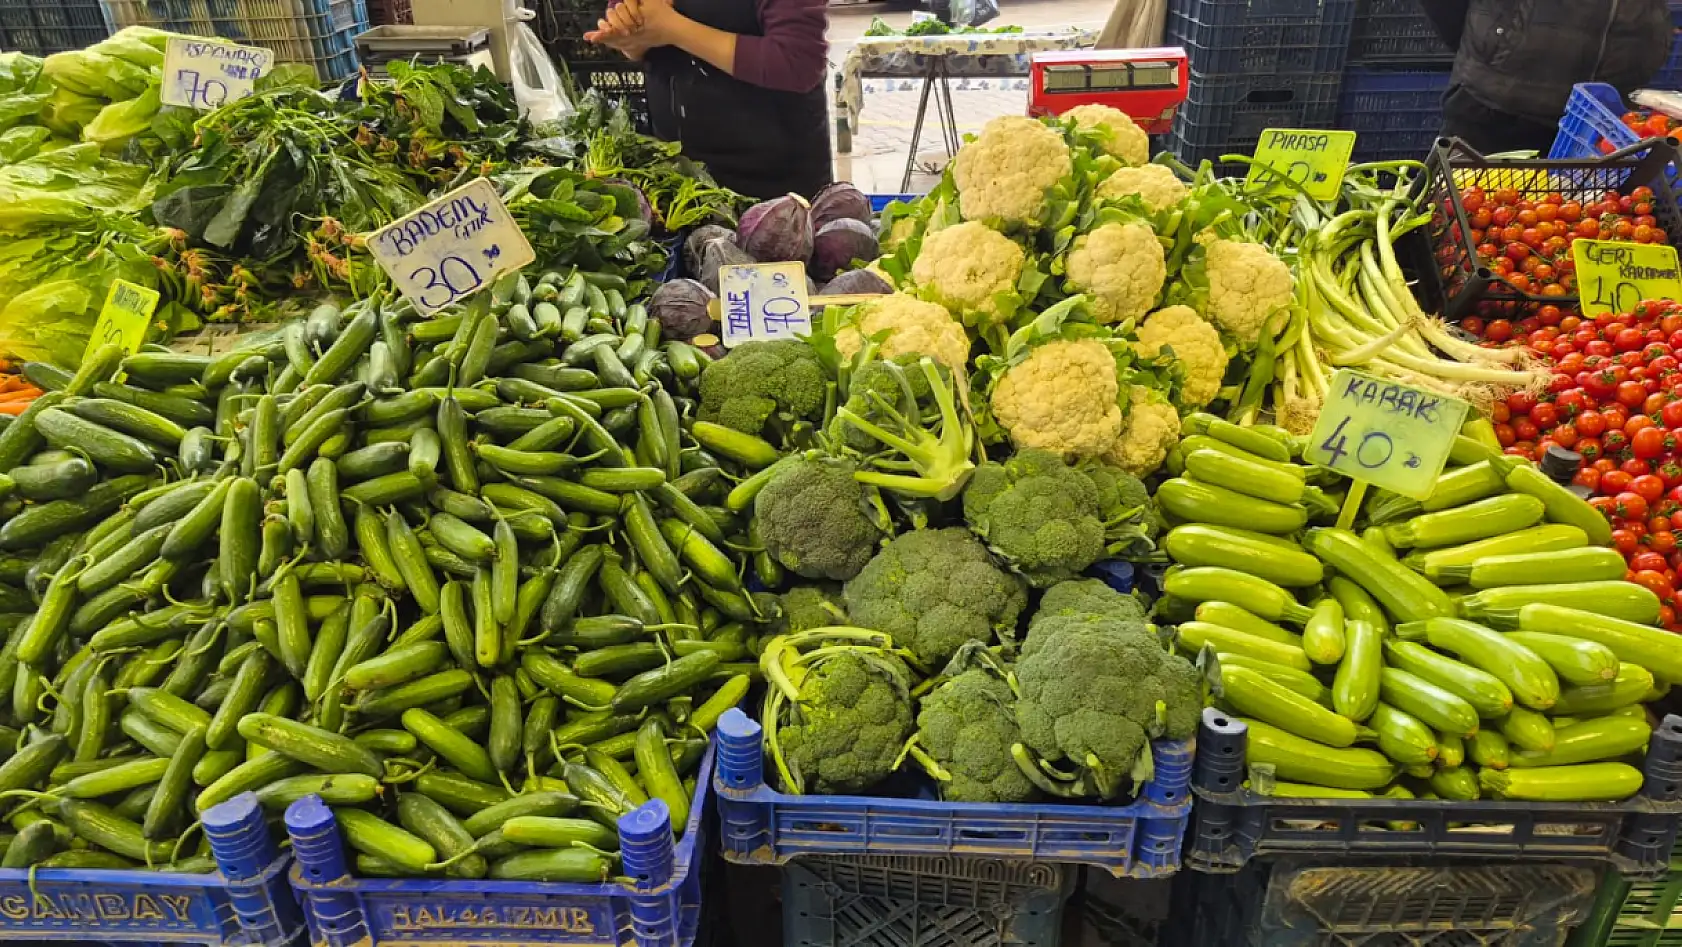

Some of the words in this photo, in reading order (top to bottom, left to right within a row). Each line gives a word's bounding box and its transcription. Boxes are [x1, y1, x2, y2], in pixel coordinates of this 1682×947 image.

[1268, 131, 1328, 152] PIRASA
[380, 196, 486, 257] BADEM
[727, 288, 749, 335] TANE
[1341, 377, 1440, 423] KABAK
